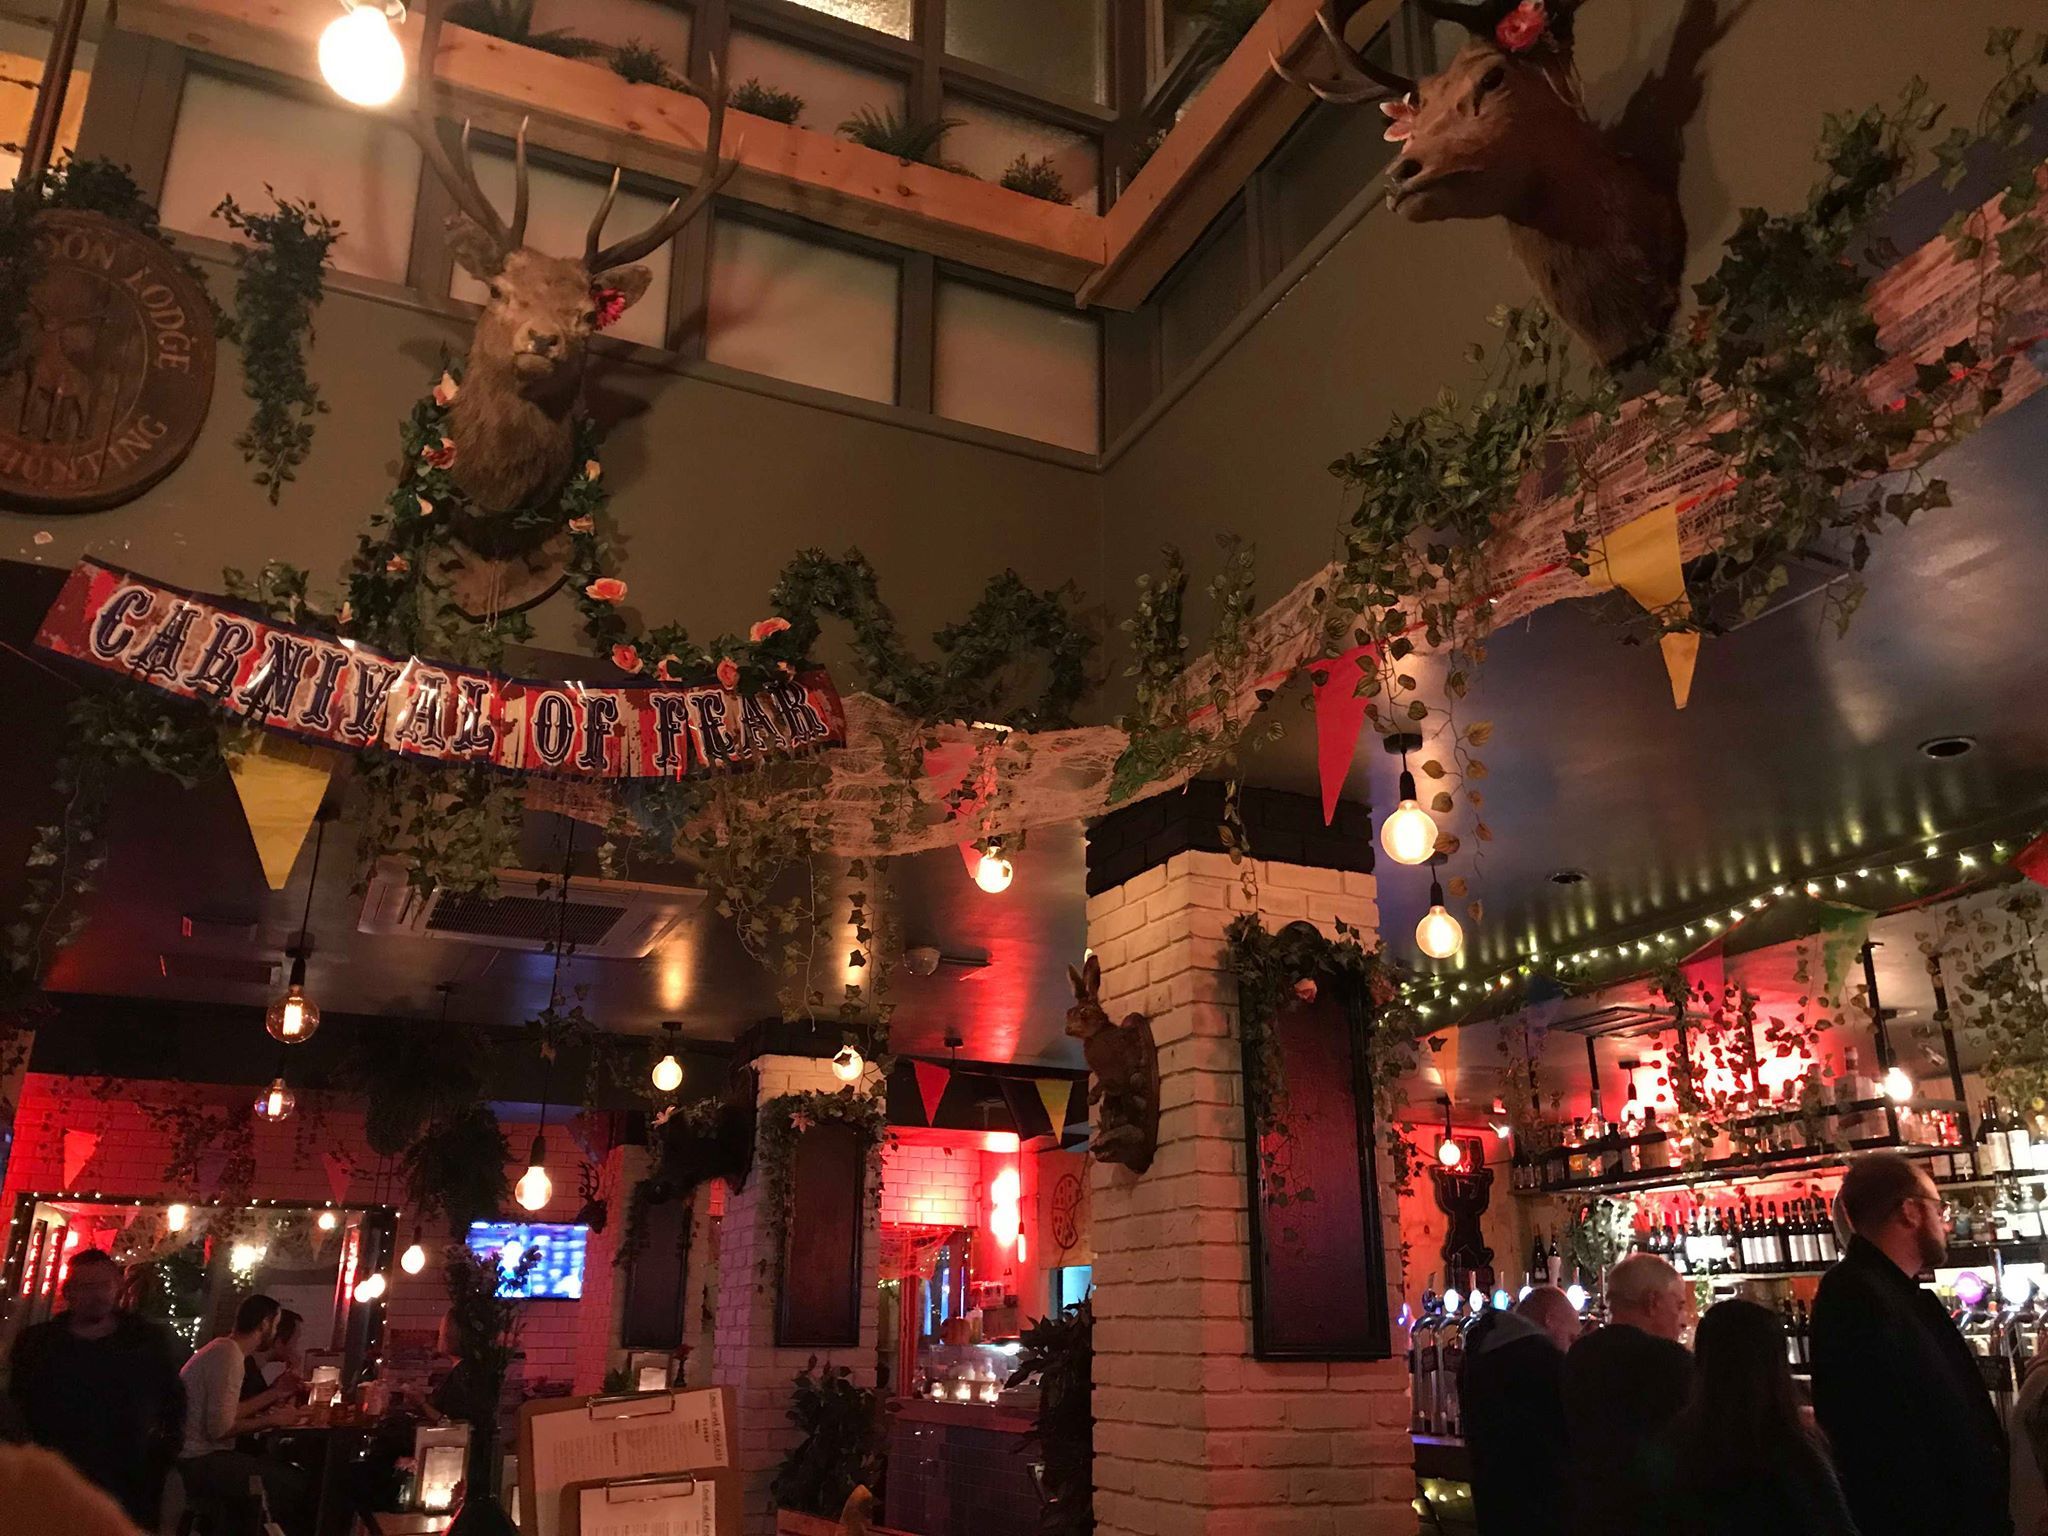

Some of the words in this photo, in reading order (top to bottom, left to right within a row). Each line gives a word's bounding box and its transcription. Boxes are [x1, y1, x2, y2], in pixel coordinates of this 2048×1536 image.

[123, 265, 191, 373] LODGE
[90, 586, 496, 752] CARNIVAL
[532, 690, 618, 769] OF
[651, 680, 830, 768] FEAR
